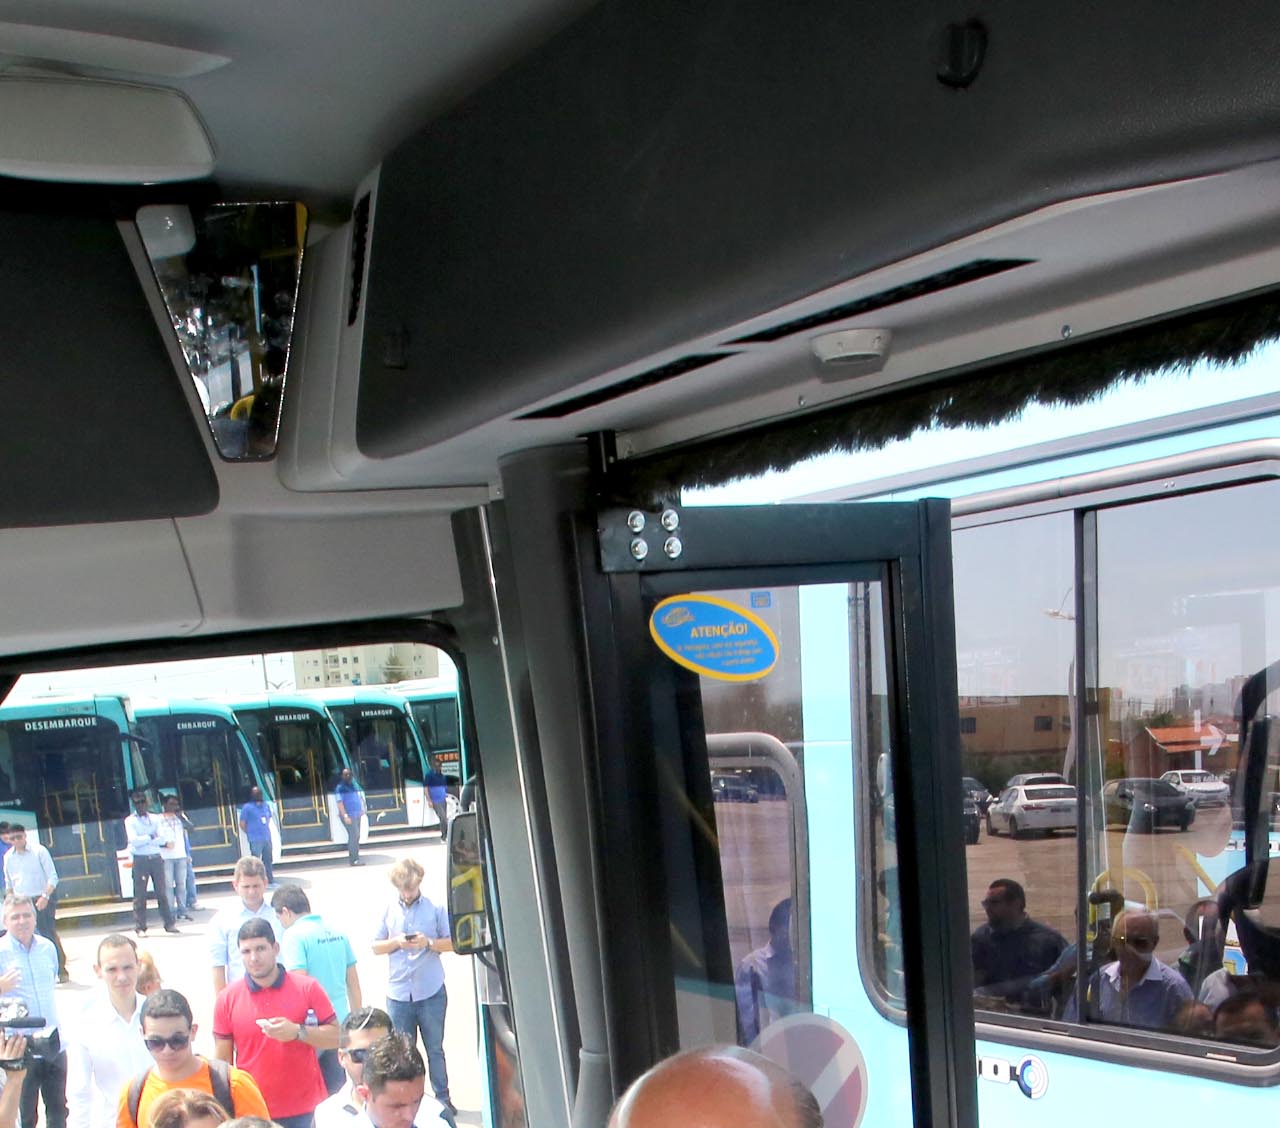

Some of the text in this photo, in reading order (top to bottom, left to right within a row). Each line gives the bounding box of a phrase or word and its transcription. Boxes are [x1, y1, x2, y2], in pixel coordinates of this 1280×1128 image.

[691, 621, 748, 639] ATENÇÃO!
[275, 713, 311, 722] EMBARQUE
[361, 709, 393, 717] EMBARQUE
[25, 716, 98, 731] DESEMBARQUE
[176, 720, 217, 730] EMBARQUE
